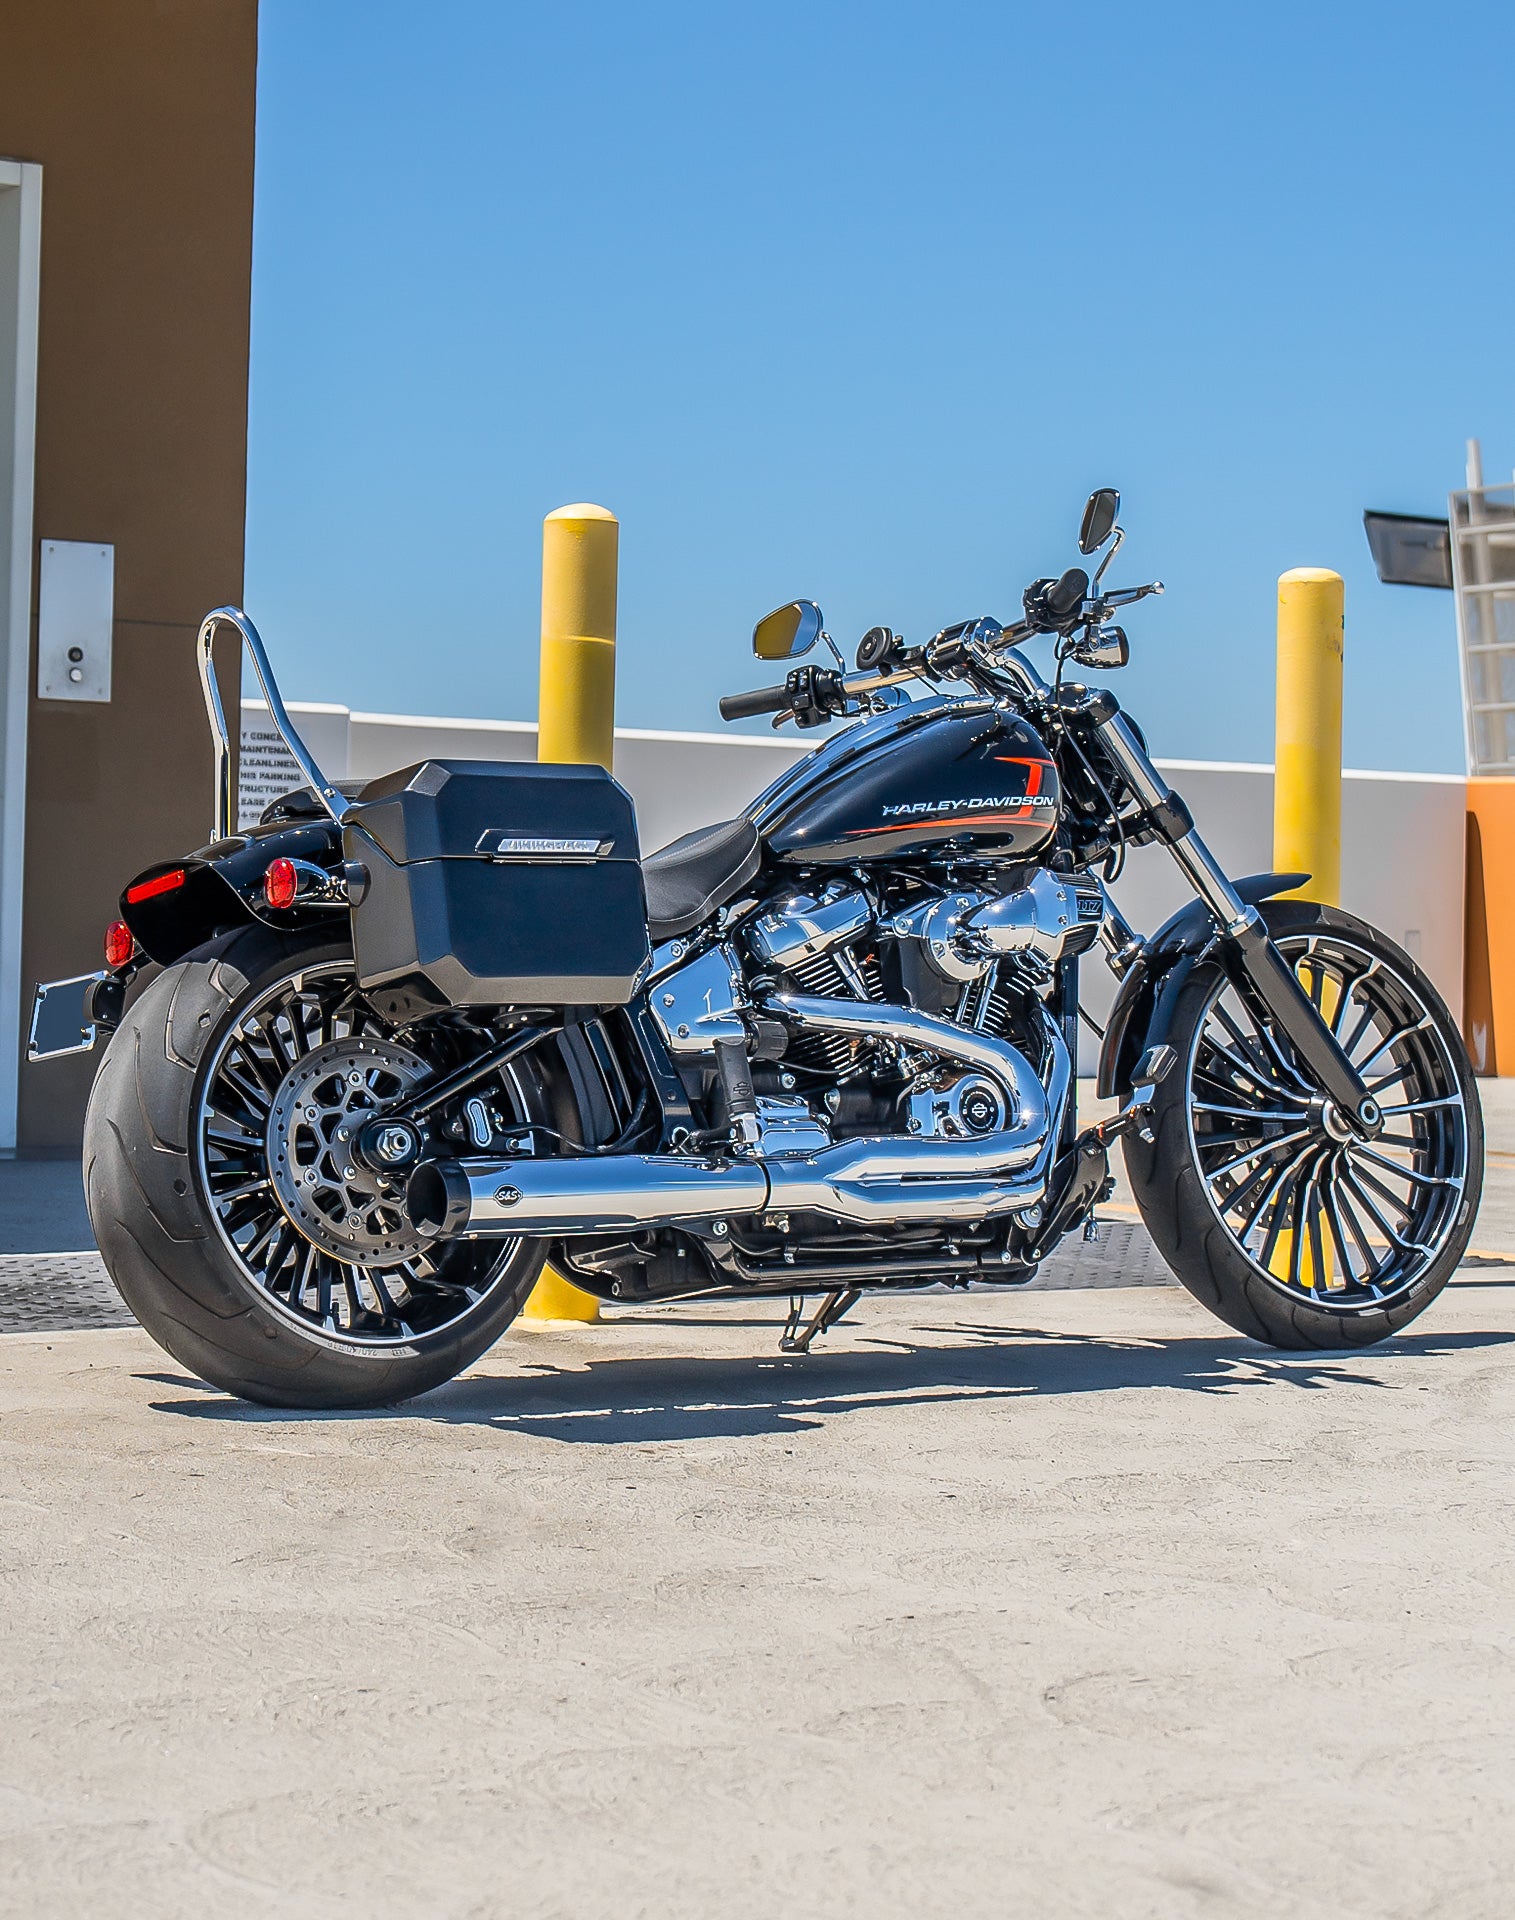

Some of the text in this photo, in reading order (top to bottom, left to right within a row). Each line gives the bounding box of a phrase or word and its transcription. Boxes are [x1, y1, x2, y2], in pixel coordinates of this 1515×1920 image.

[259, 772, 300, 781] PARKING
[882, 796, 1055, 816] HARLEY-DAVIDSON
[498, 1191, 518, 1200] S&S
